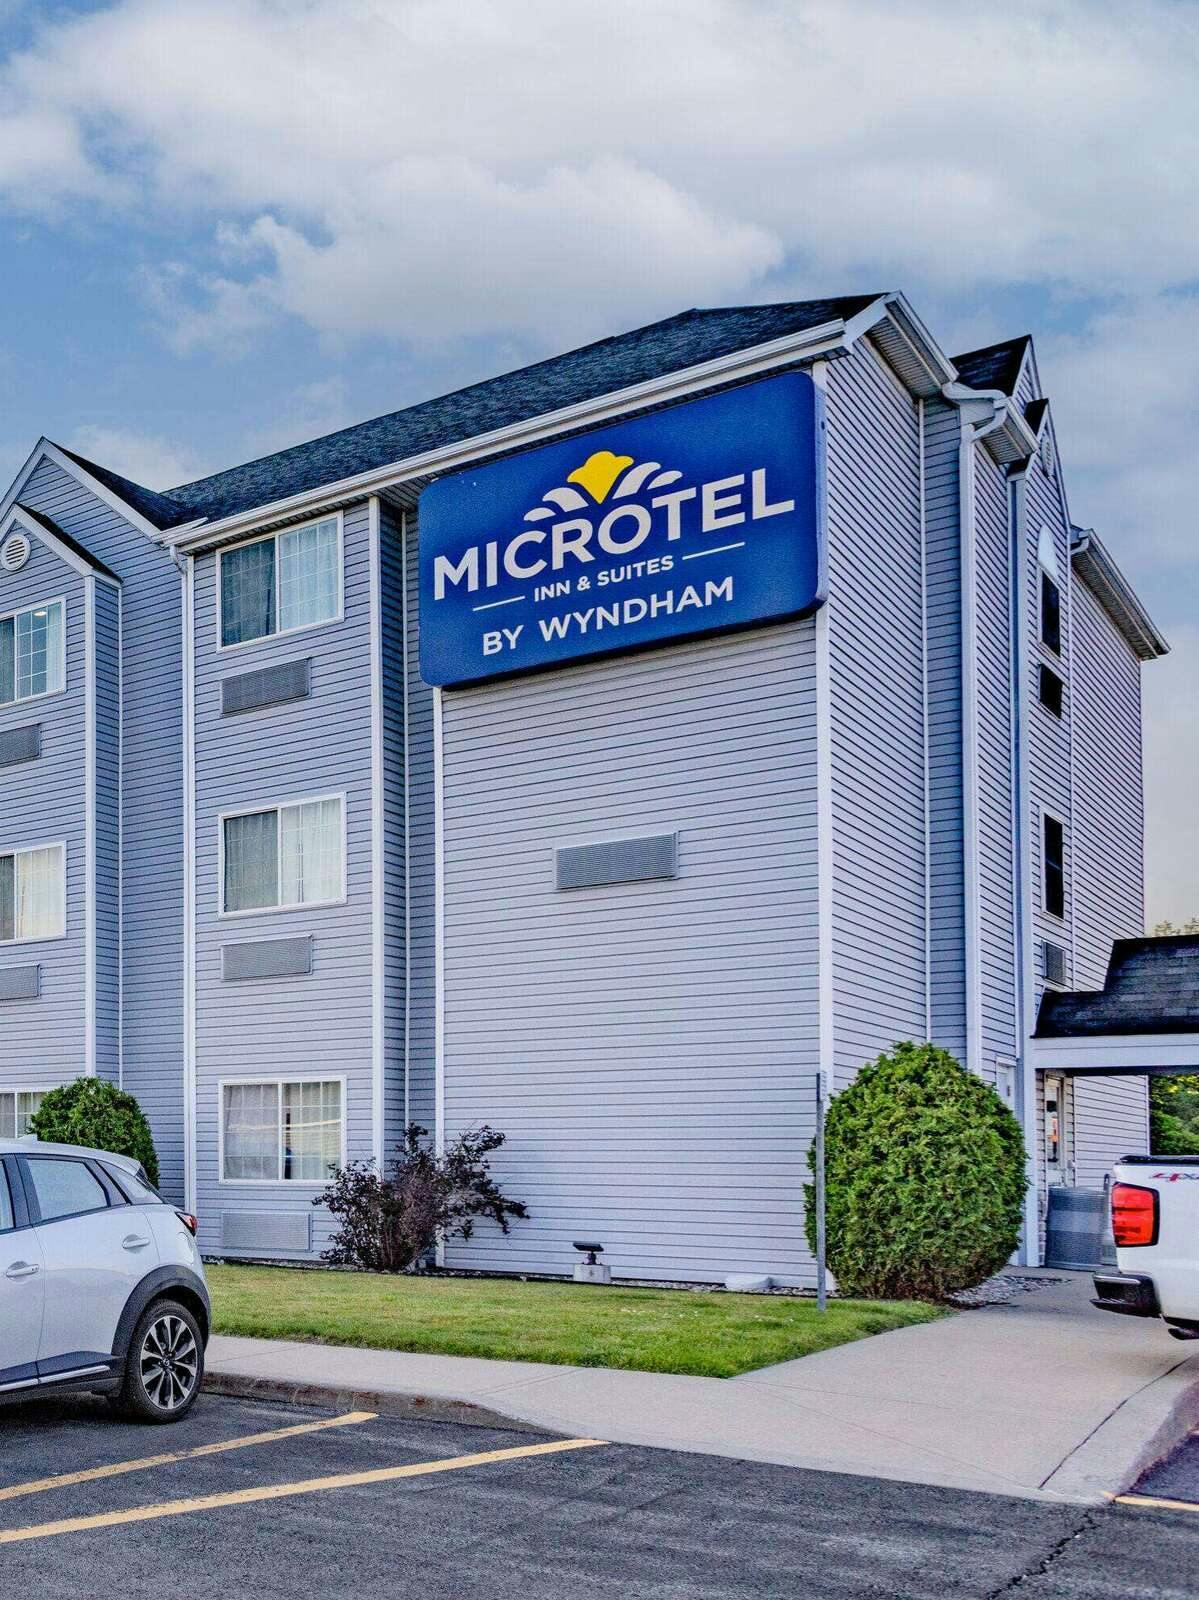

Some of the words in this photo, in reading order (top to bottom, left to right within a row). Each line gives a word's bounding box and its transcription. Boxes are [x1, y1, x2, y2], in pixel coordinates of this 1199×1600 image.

[433, 468, 795, 601] MICROTEL
[482, 625, 524, 656] BY
[538, 576, 733, 642] WYNDHAM
[534, 580, 571, 602] INN
[577, 575, 591, 591] &
[597, 555, 675, 587] SUITES
